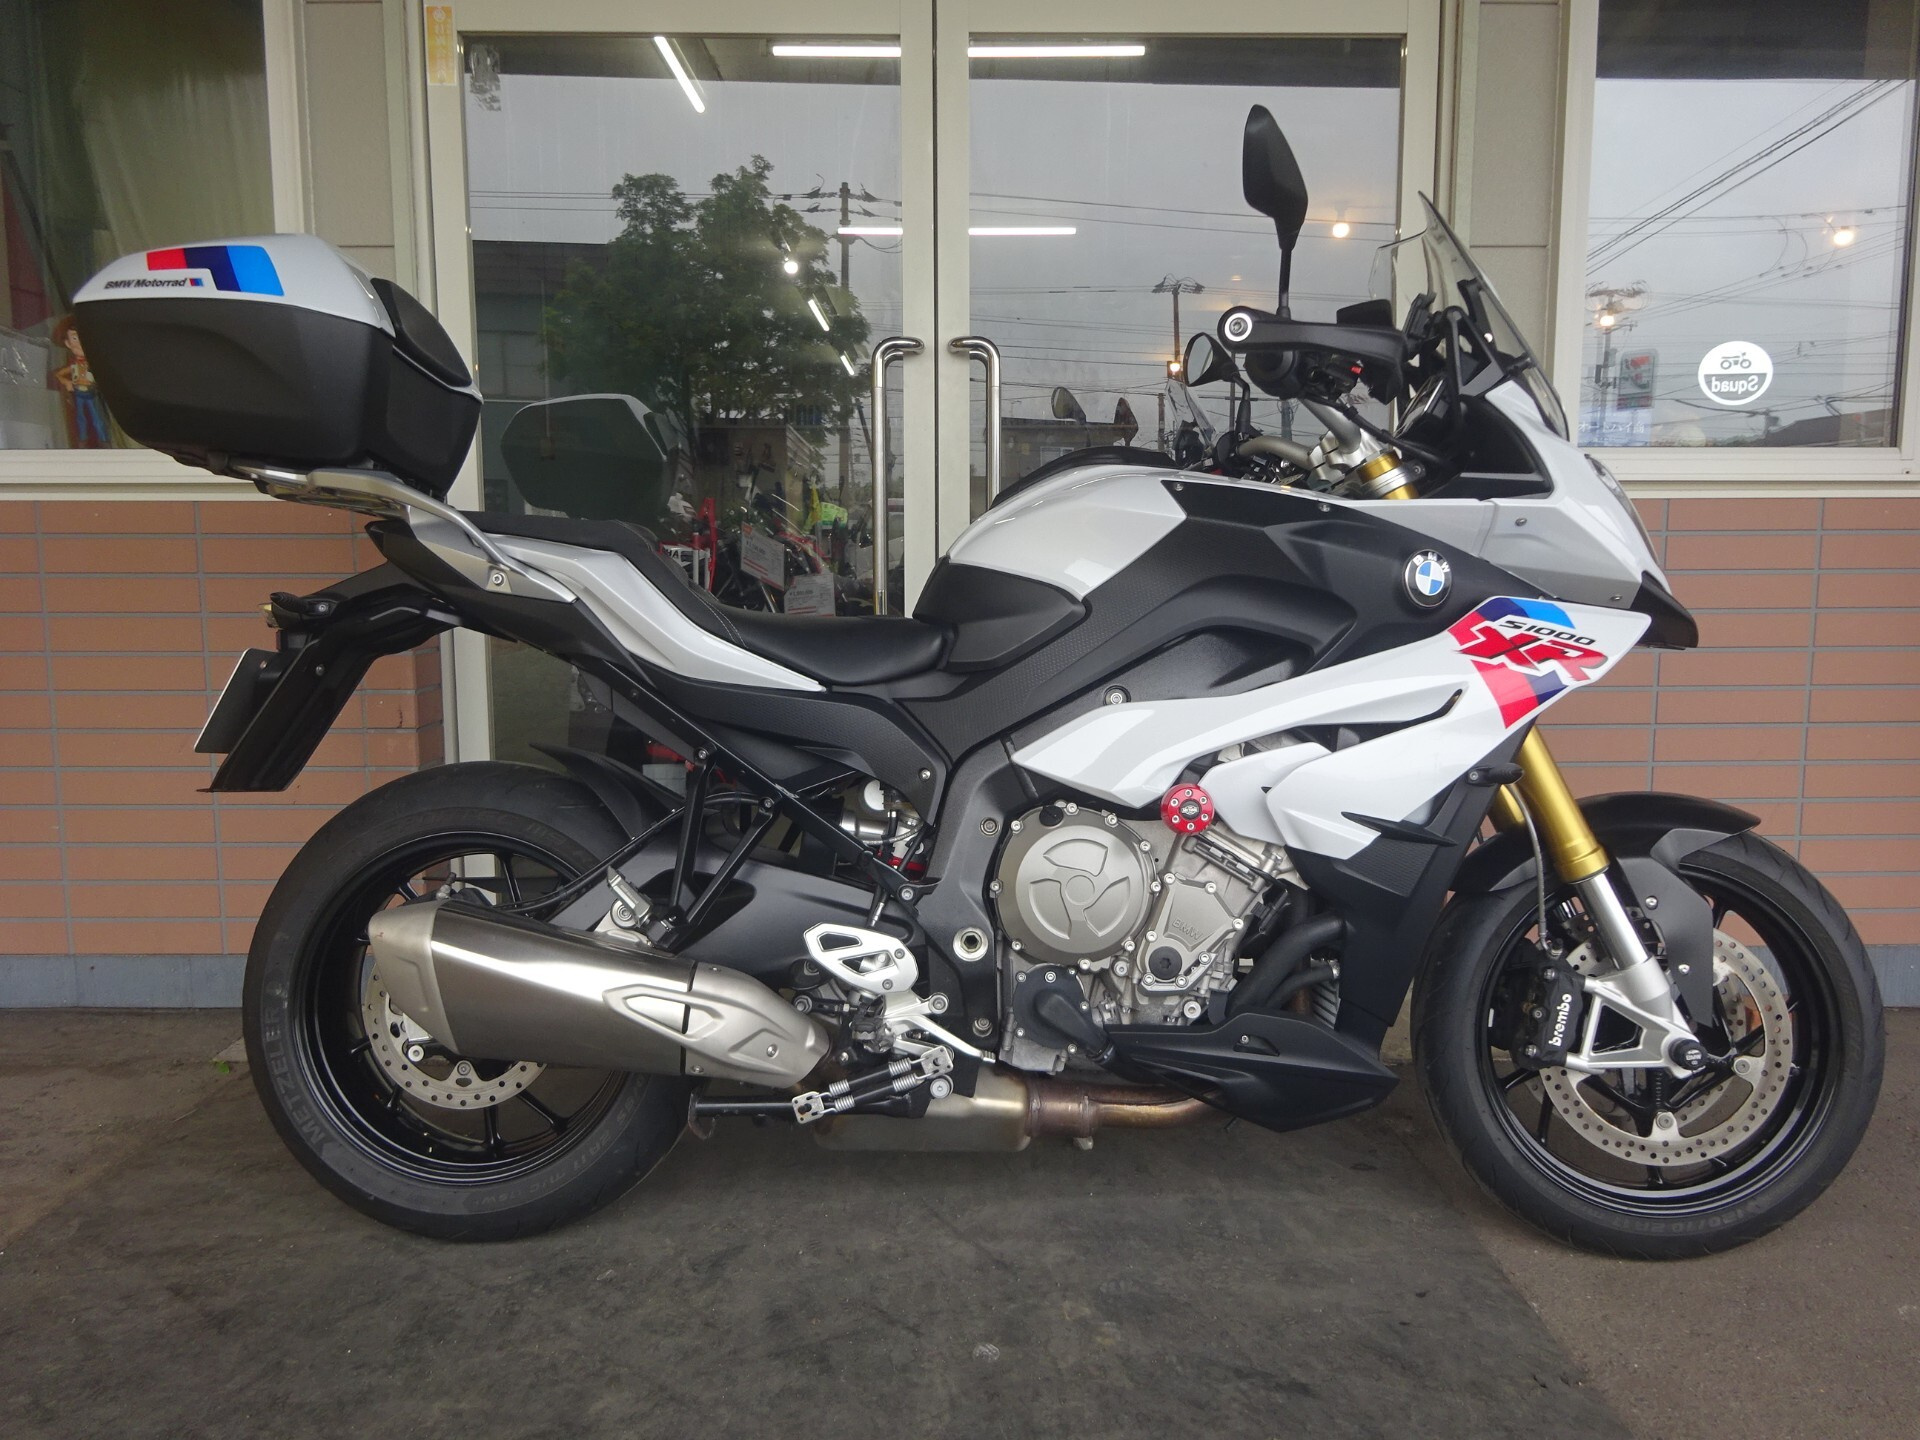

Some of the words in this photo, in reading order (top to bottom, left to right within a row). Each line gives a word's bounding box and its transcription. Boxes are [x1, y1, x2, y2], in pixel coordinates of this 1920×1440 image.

[104, 279, 134, 290] BMW
[134, 277, 188, 288] Motorrad
[1412, 551, 1450, 573] BMW
[1499, 619, 1596, 646] S1000
[1457, 625, 1608, 682] XR
[1171, 918, 1204, 941] BMW
[1548, 993, 1572, 1047] brembo
[264, 1006, 326, 1145] METZELER
